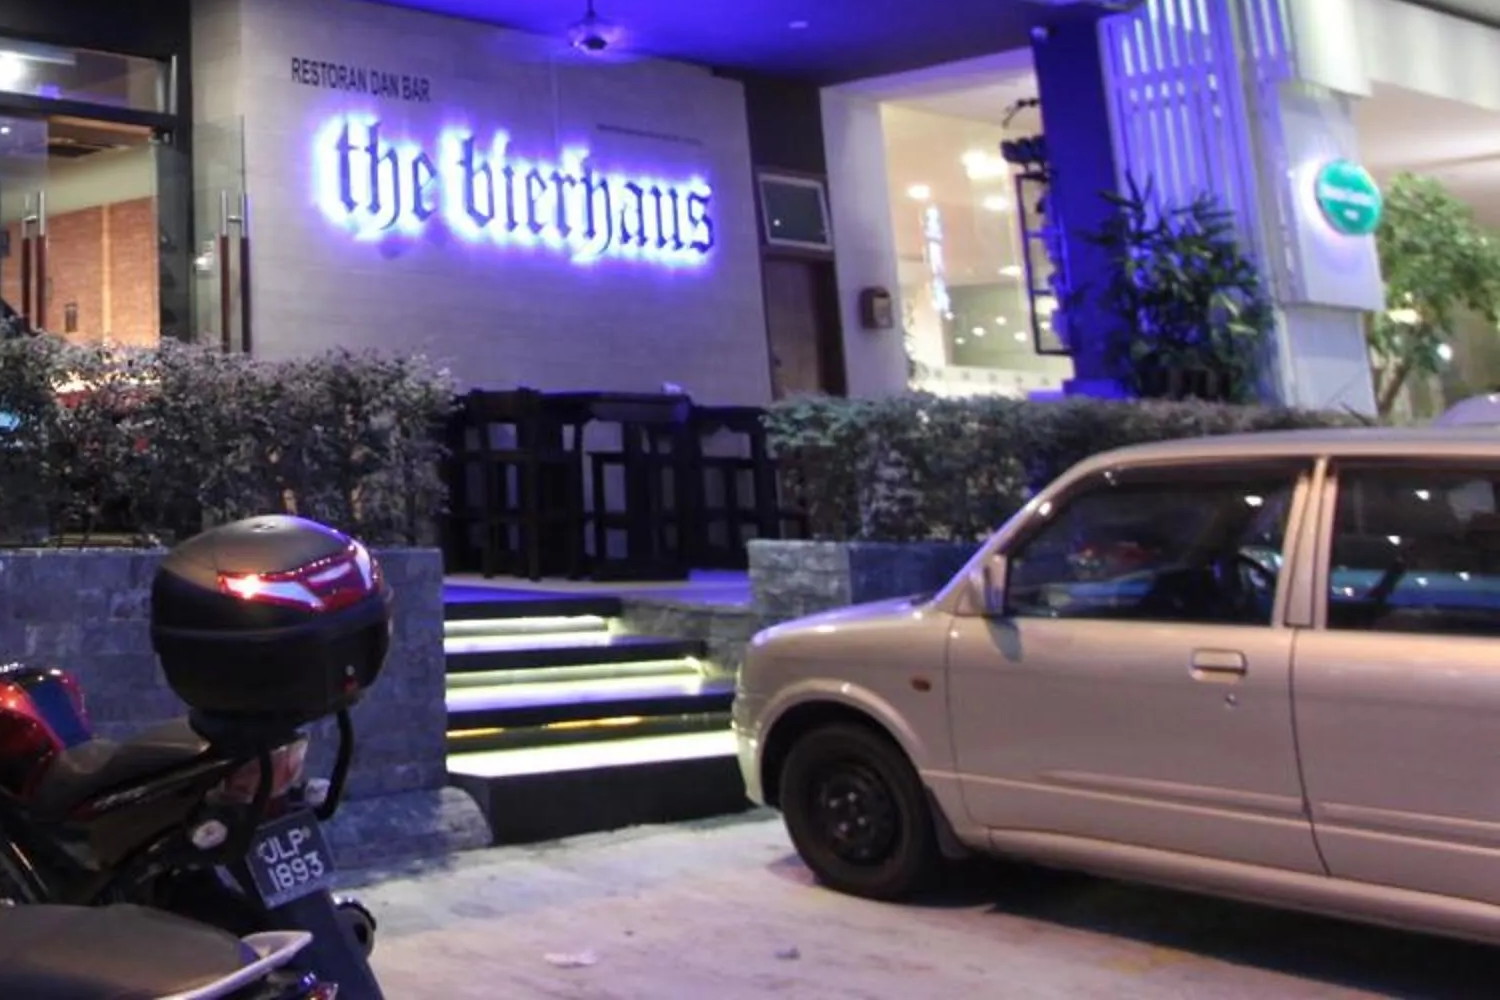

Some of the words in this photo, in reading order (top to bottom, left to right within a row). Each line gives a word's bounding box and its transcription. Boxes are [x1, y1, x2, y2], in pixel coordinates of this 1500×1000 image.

[291, 57, 368, 93] RESTORAN
[370, 69, 400, 99] DAN
[401, 75, 431, 102] BAR
[336, 119, 438, 231] the
[456, 134, 715, 254] bierhaus
[260, 827, 304, 865] JLP
[267, 851, 325, 892] 1893
